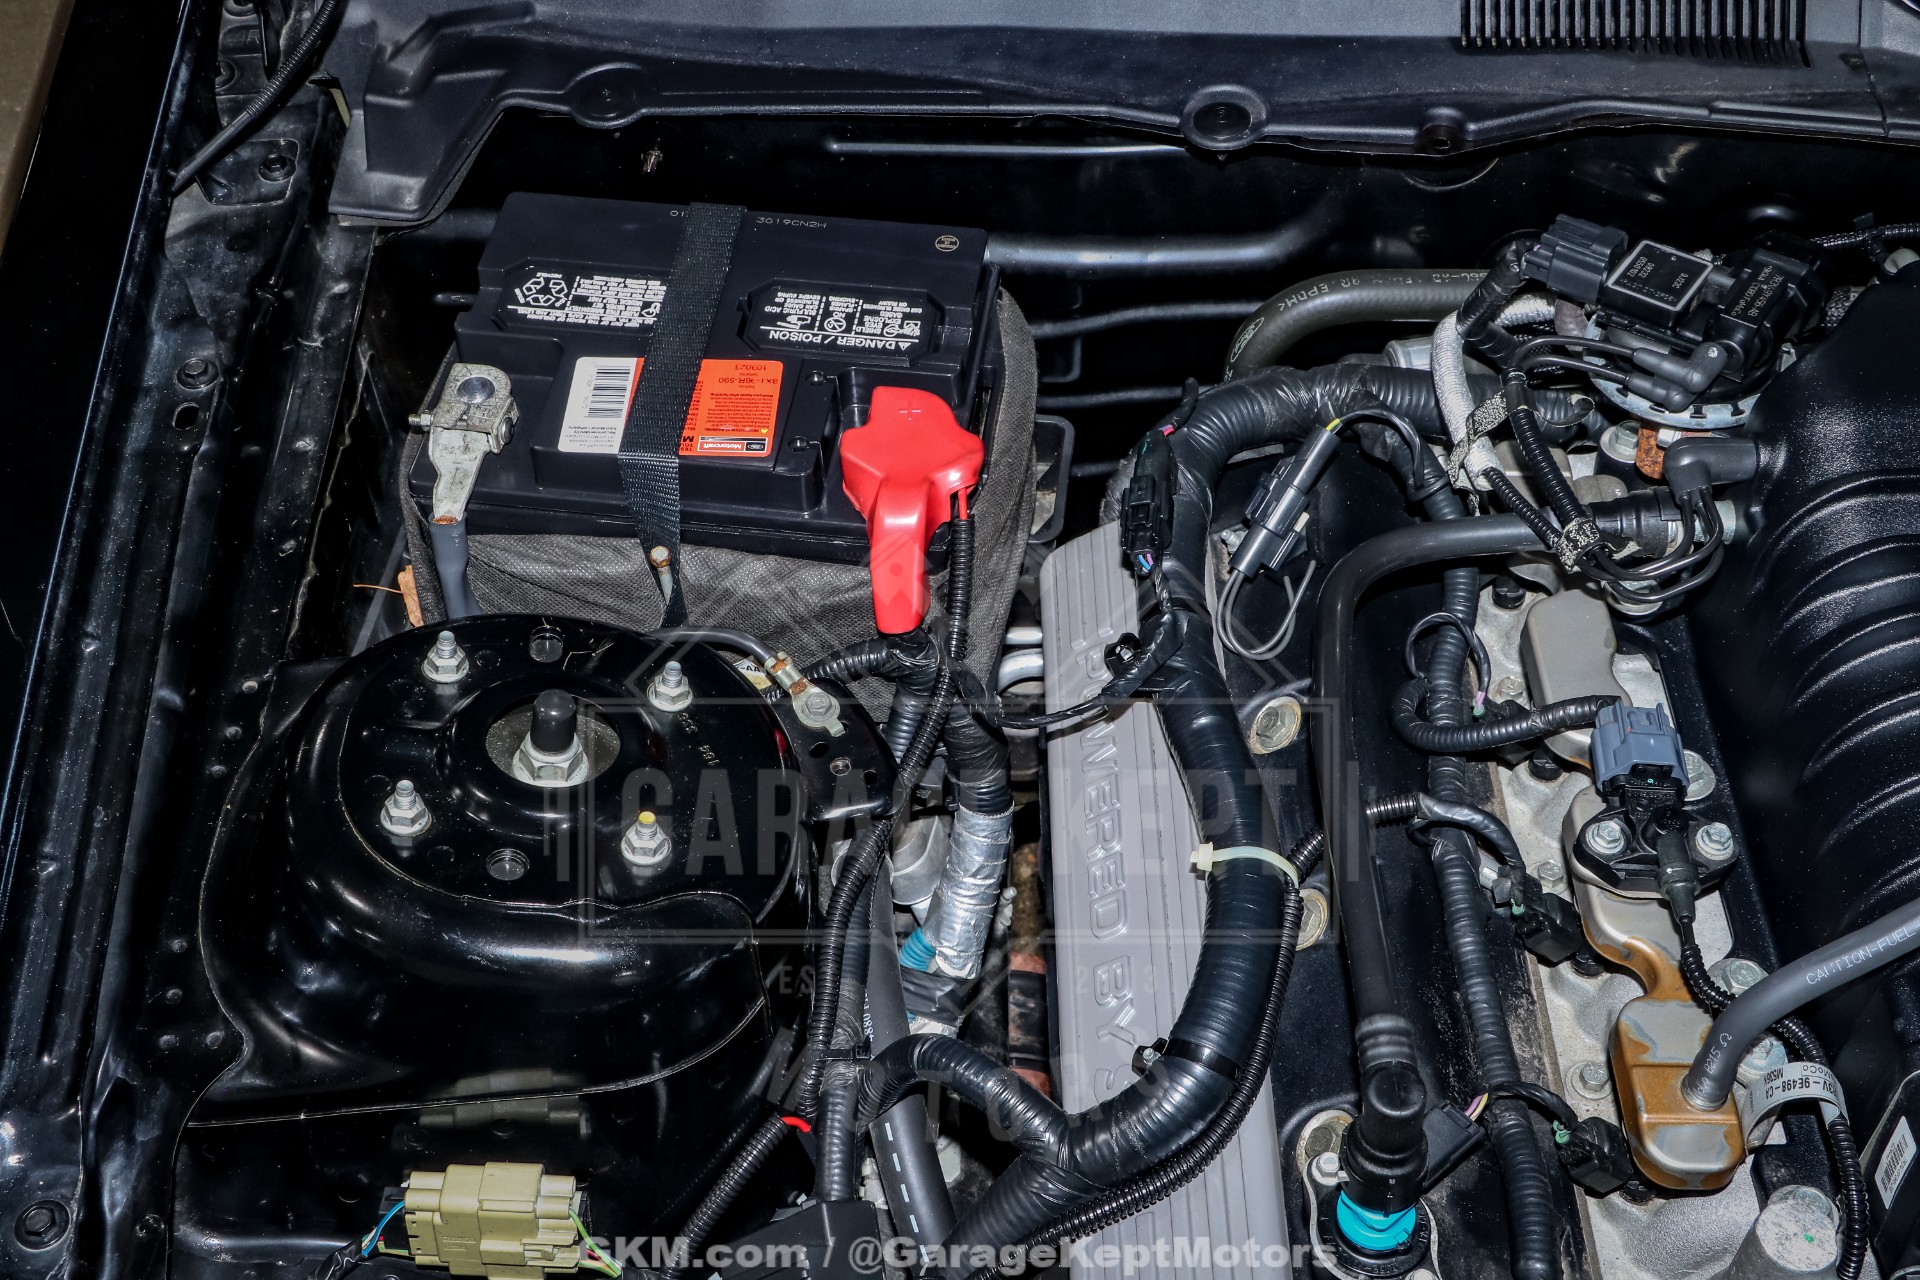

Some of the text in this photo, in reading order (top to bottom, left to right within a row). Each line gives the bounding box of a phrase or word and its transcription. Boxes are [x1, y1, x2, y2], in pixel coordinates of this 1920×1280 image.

[783, 307, 817, 315] SULFURIC
[863, 315, 902, 324] EXPLOSIVE
[856, 326, 882, 334] SHIELD
[769, 330, 822, 343] POISON
[836, 336, 896, 350] DANGER
[1093, 955, 1137, 1047] BY
